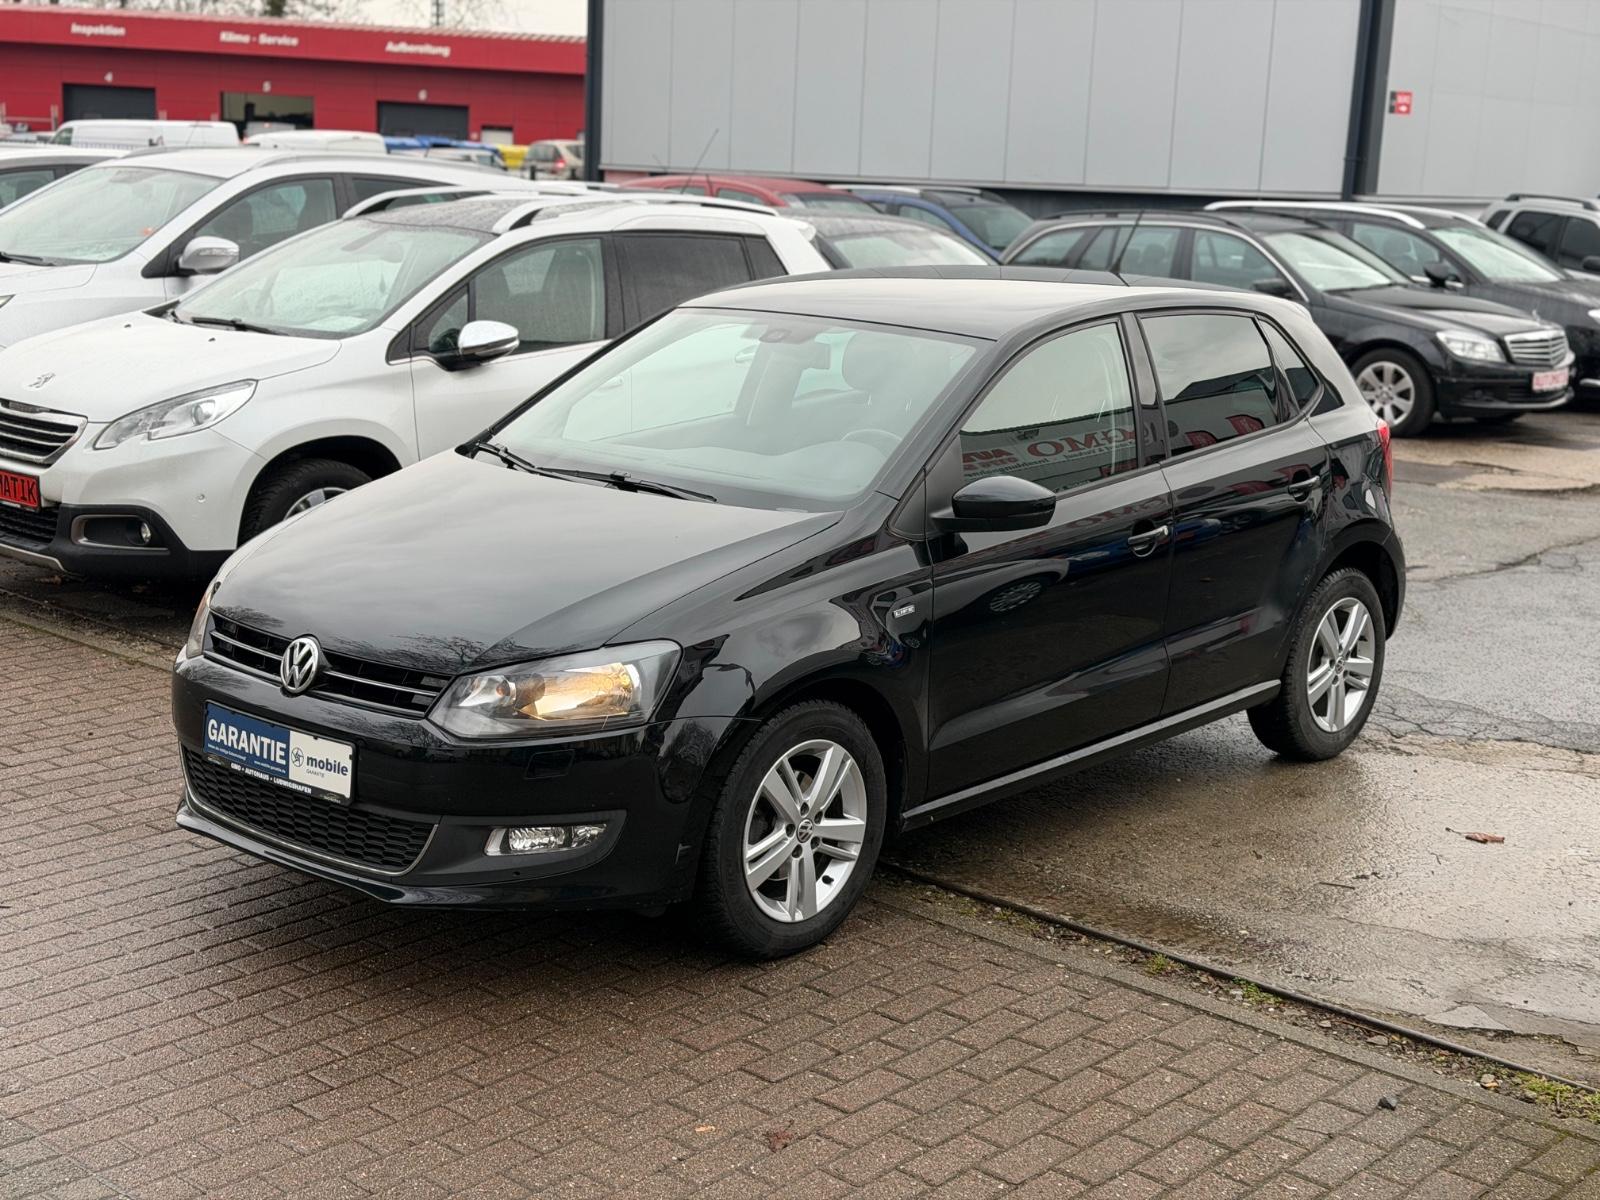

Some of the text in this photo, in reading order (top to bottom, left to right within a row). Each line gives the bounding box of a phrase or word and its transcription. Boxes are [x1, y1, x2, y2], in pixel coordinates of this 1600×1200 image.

[70, 22, 126, 37] Inspektion
[258, 33, 299, 47] Service
[385, 41, 451, 58] Aufbereitung
[104, 71, 113, 82] 4
[208, 718, 287, 766] GARANTIE
[306, 756, 349, 776] mobile
[244, 767, 270, 781] AUTOHAUS
